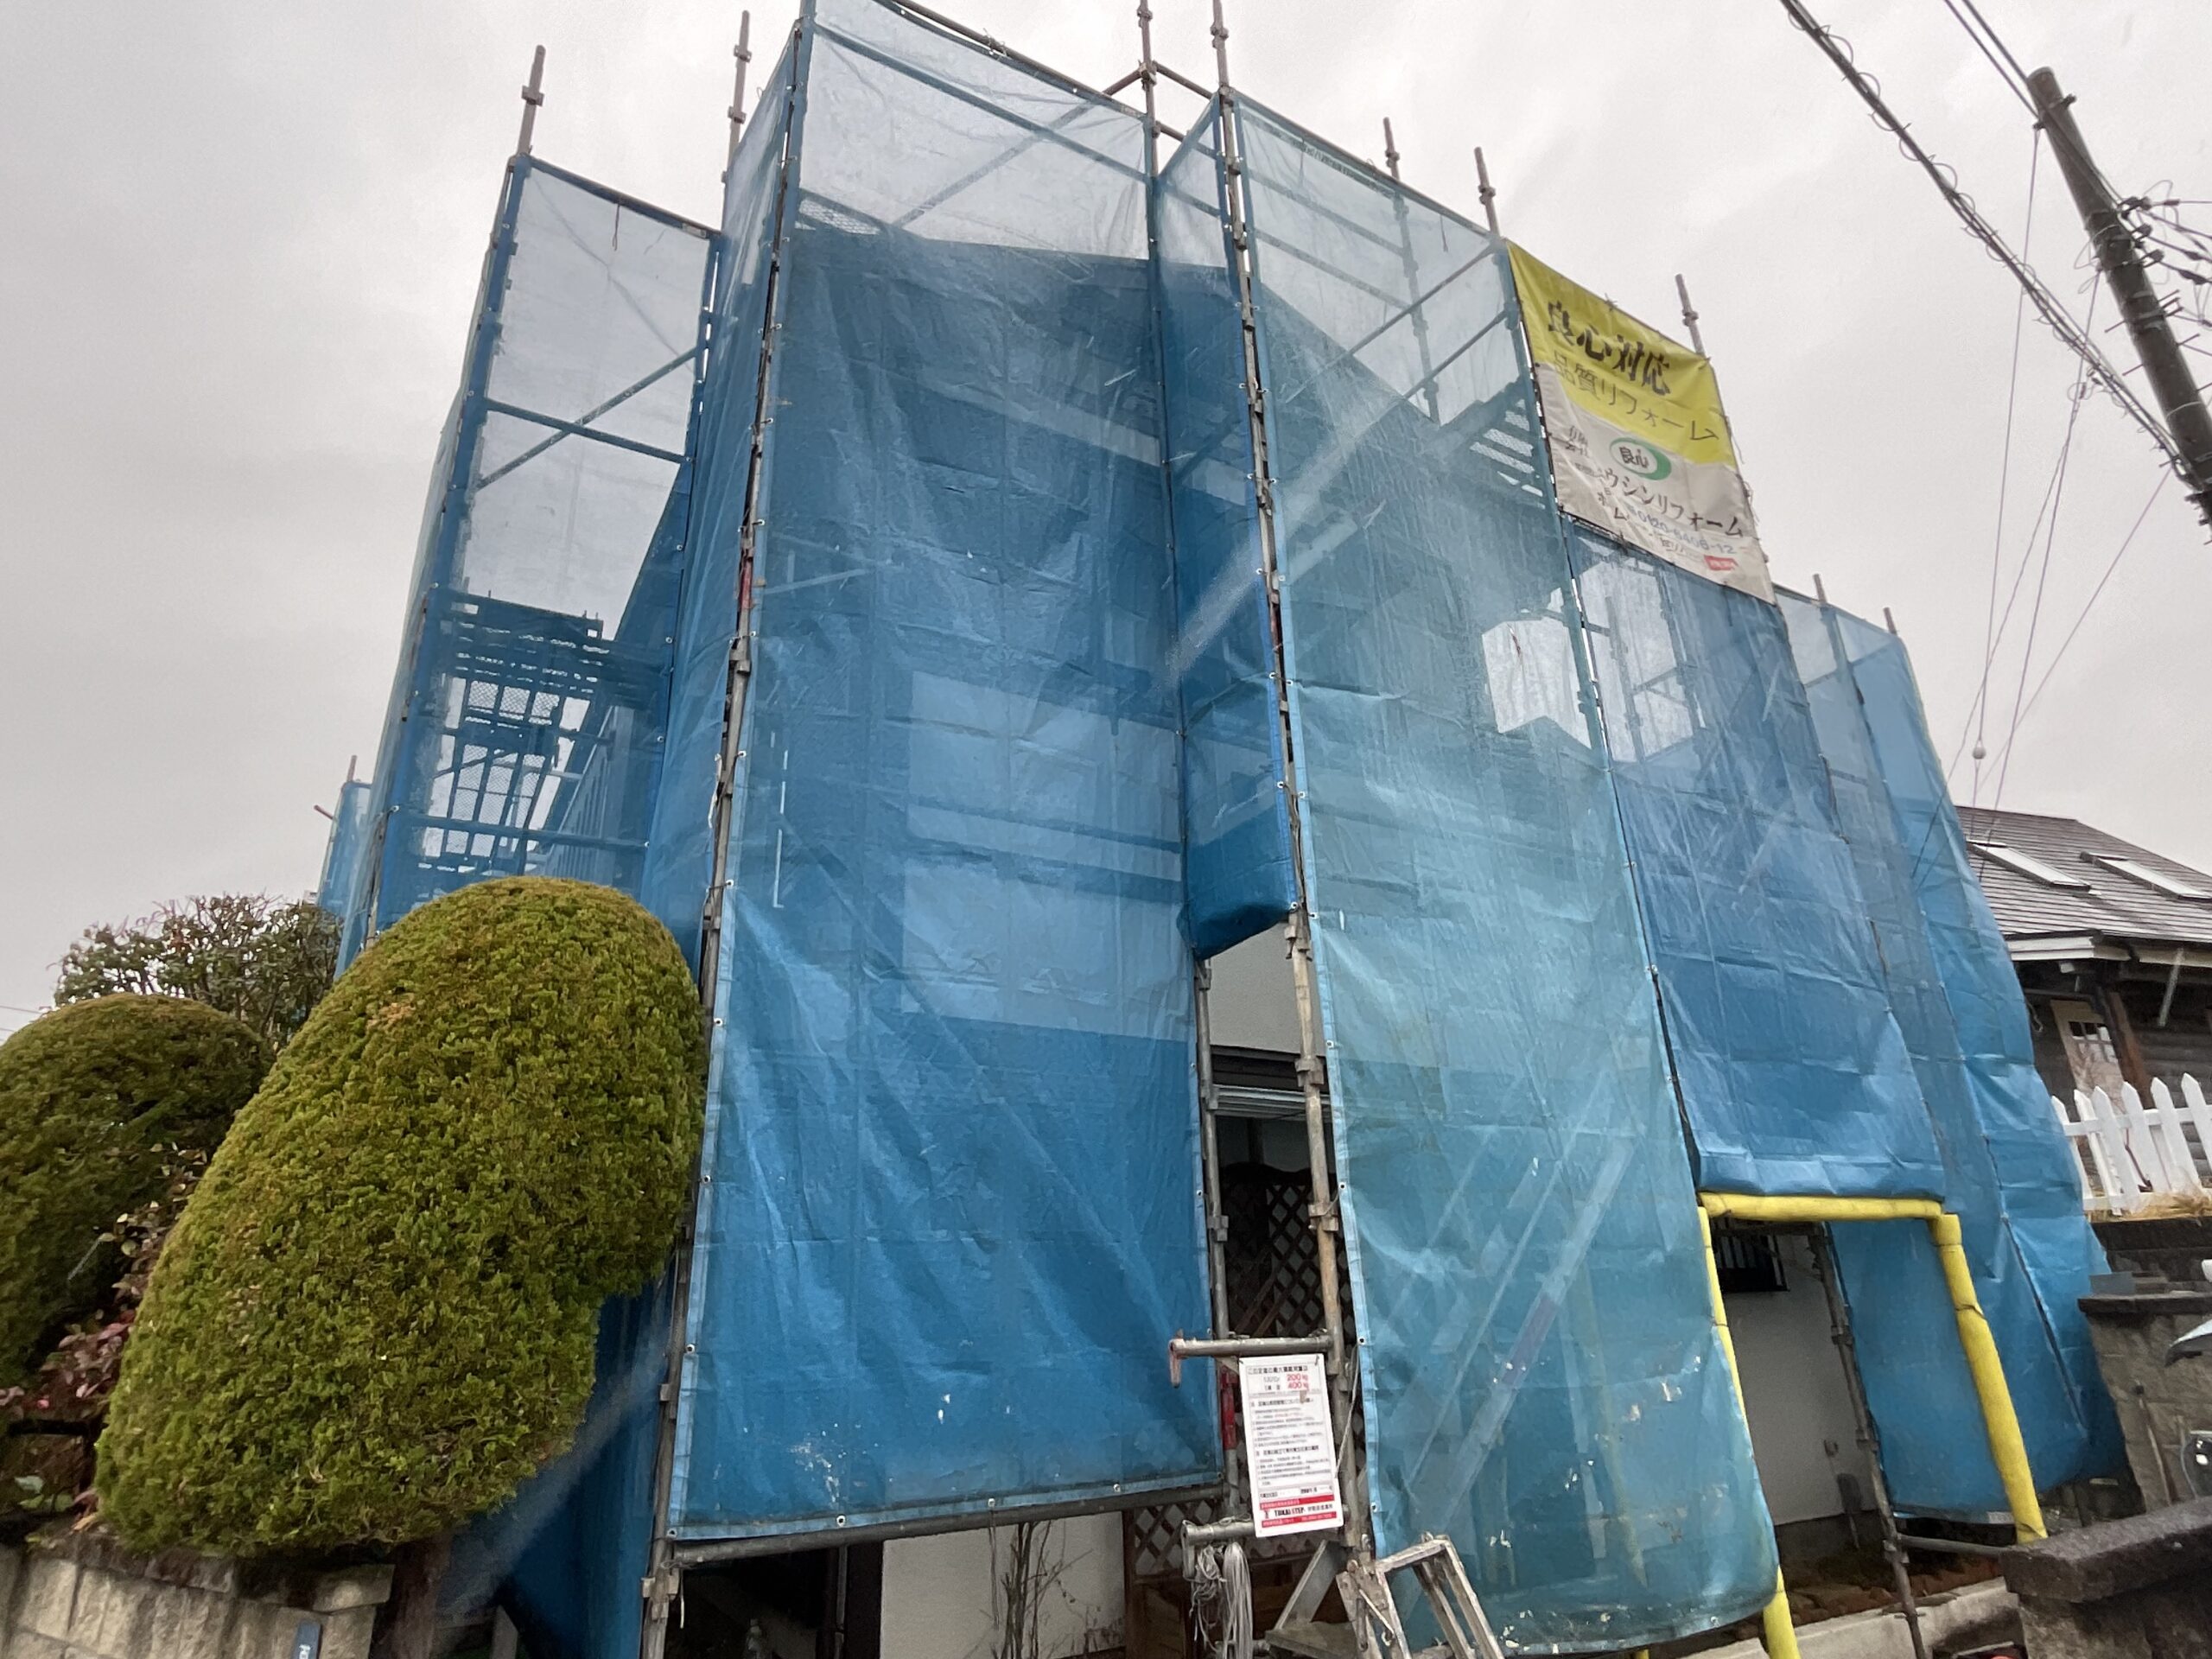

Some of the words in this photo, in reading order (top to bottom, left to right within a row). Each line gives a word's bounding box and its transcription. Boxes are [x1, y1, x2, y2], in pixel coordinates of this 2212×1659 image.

[1554, 349, 1719, 441] 品質リフォーム
